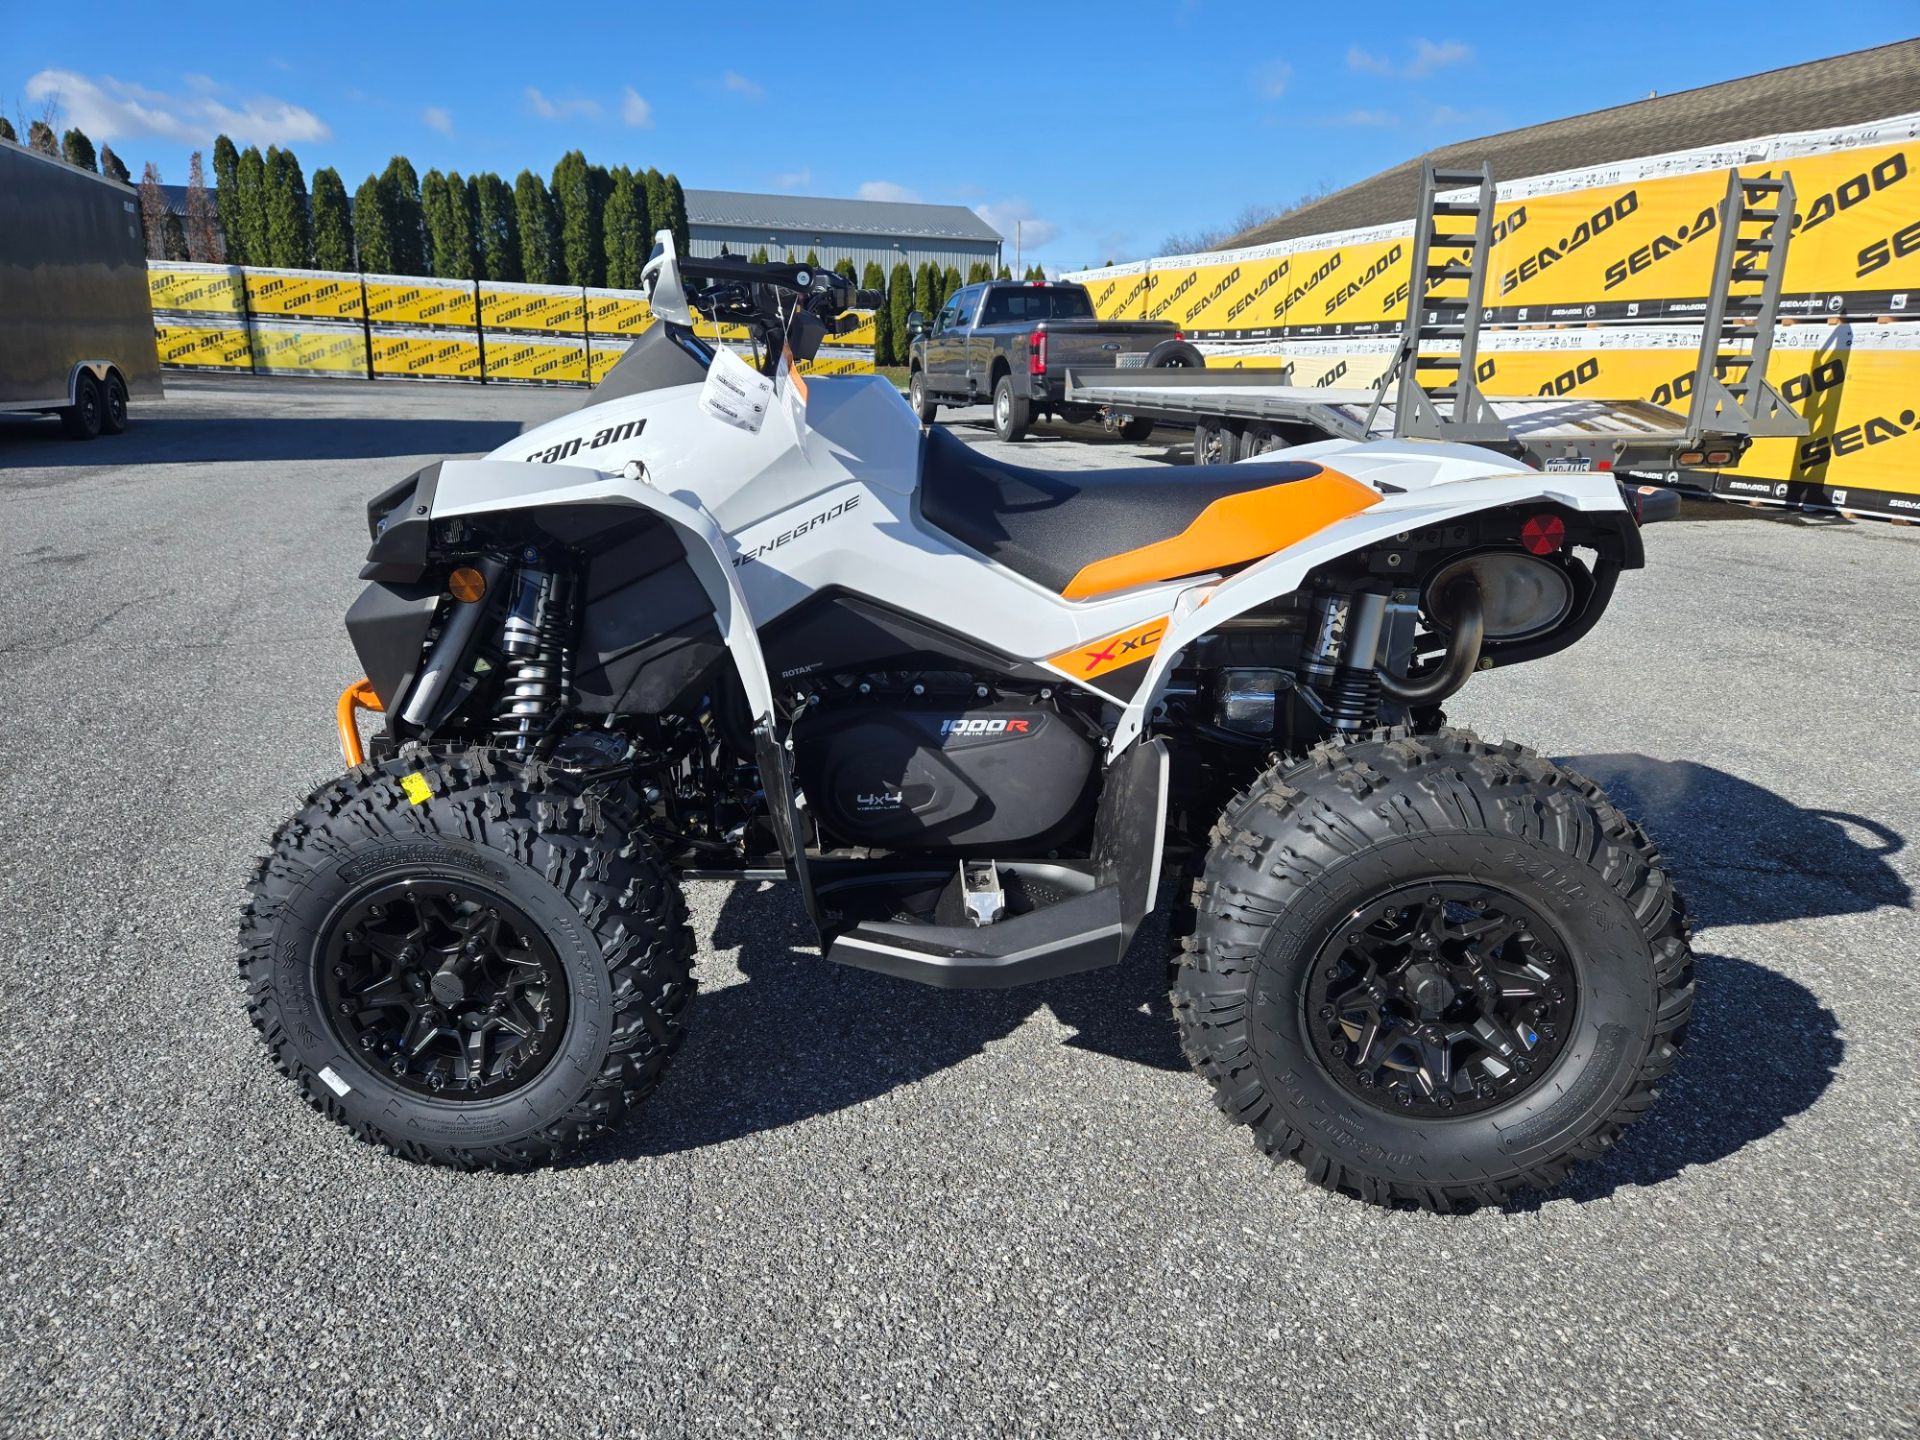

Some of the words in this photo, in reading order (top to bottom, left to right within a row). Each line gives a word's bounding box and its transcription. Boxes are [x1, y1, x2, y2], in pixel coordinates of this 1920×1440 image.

[283, 282, 340, 311] can-am
[418, 293, 472, 319] can-am
[495, 297, 547, 324] can-am
[407, 343, 461, 371] can-am
[525, 417, 648, 465] can-am
[1320, 604, 1349, 659] FOX
[781, 664, 812, 679] ROTAX
[940, 719, 1029, 733] 1000R
